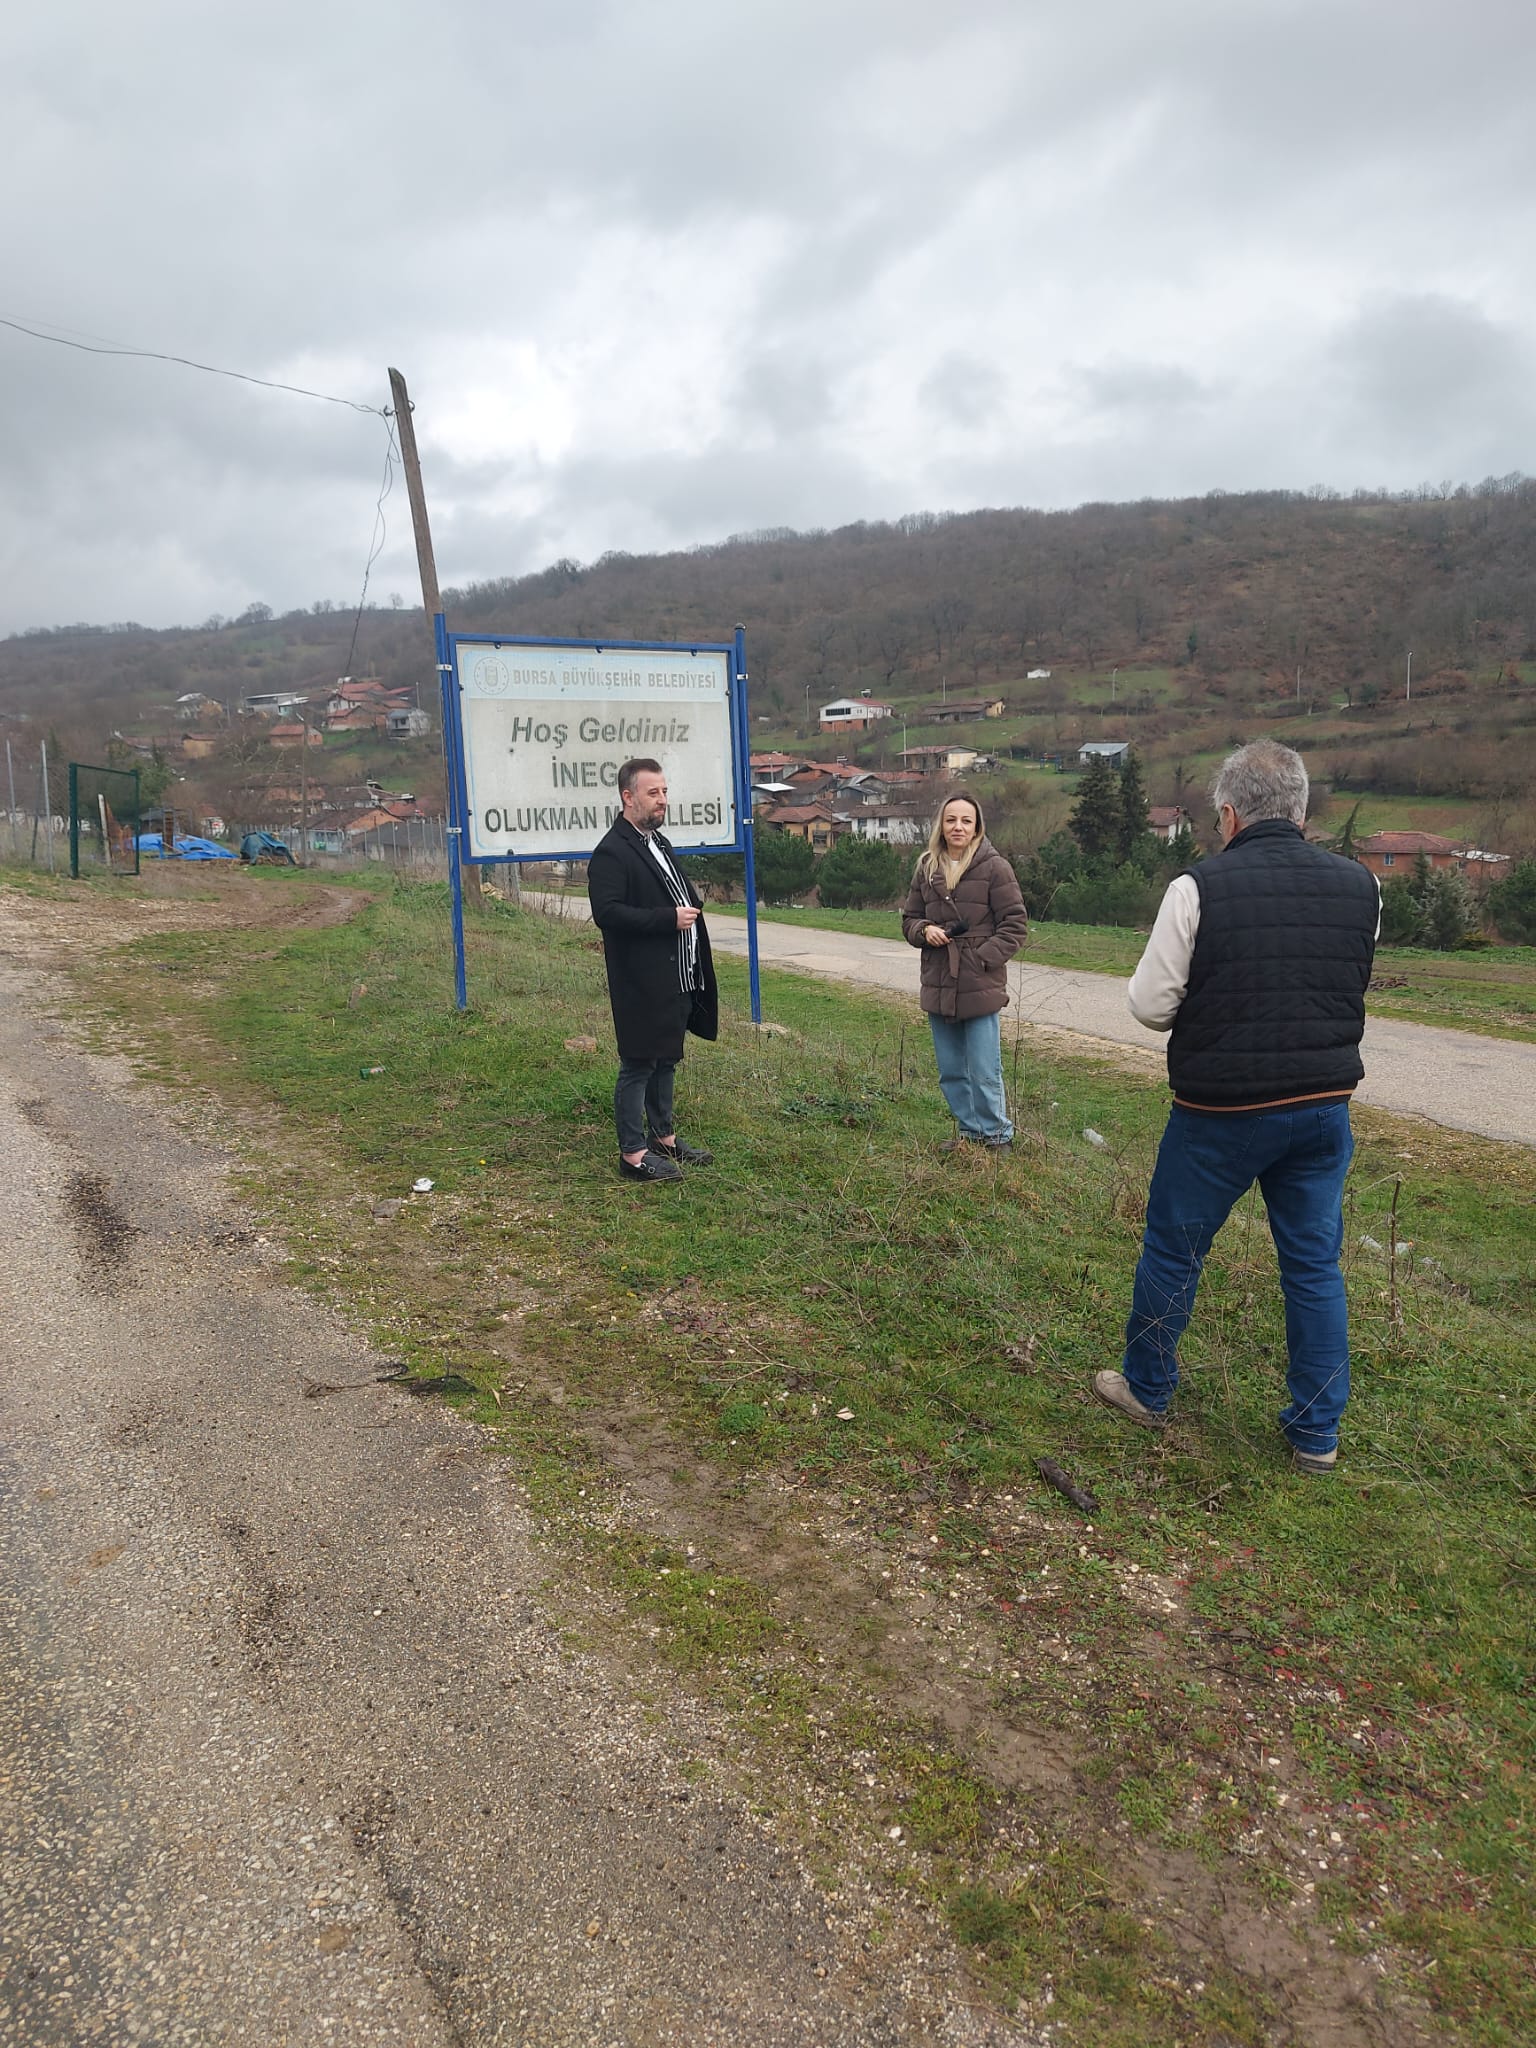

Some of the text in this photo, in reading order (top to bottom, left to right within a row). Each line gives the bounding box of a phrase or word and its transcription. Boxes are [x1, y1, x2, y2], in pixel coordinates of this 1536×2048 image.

[513, 666, 717, 690] BURSA BÜYÜKŞEHİR BELEDİYESİ
[511, 716, 690, 749] Hoş Geldiniz
[551, 754, 634, 788] İNEG
[484, 796, 722, 833] OLUKMAN MLLESİ
